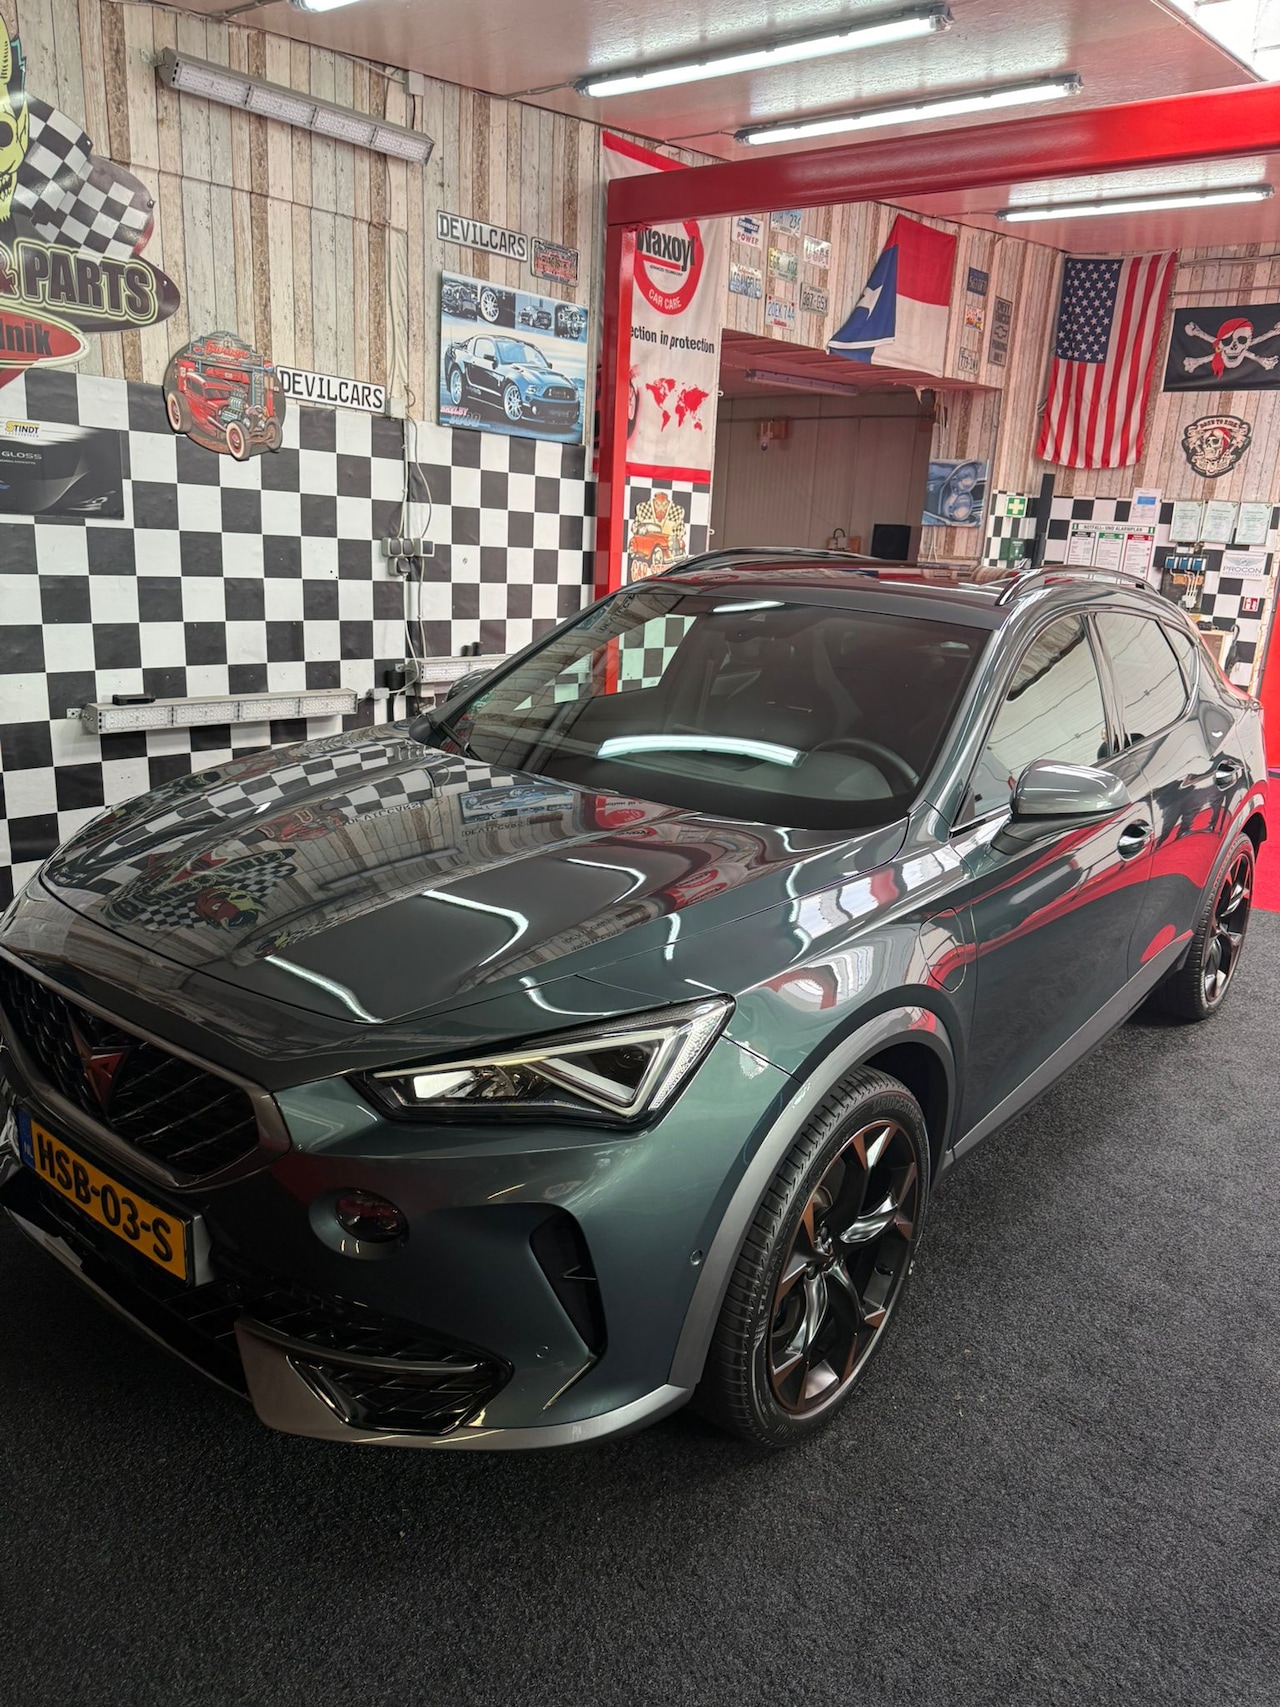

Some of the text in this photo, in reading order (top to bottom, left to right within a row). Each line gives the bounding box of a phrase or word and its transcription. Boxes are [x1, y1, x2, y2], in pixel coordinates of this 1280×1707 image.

[439, 214, 526, 257] DEVILCARS
[737, 231, 759, 244] POWER
[20, 244, 152, 318] PARTS
[648, 289, 682, 310] CAR CARE
[630, 326, 715, 354] ection in protection
[279, 370, 383, 408] DEVILCARS
[1, 450, 42, 460] GLOSS
[37, 1132, 173, 1262] HSB-03-S
